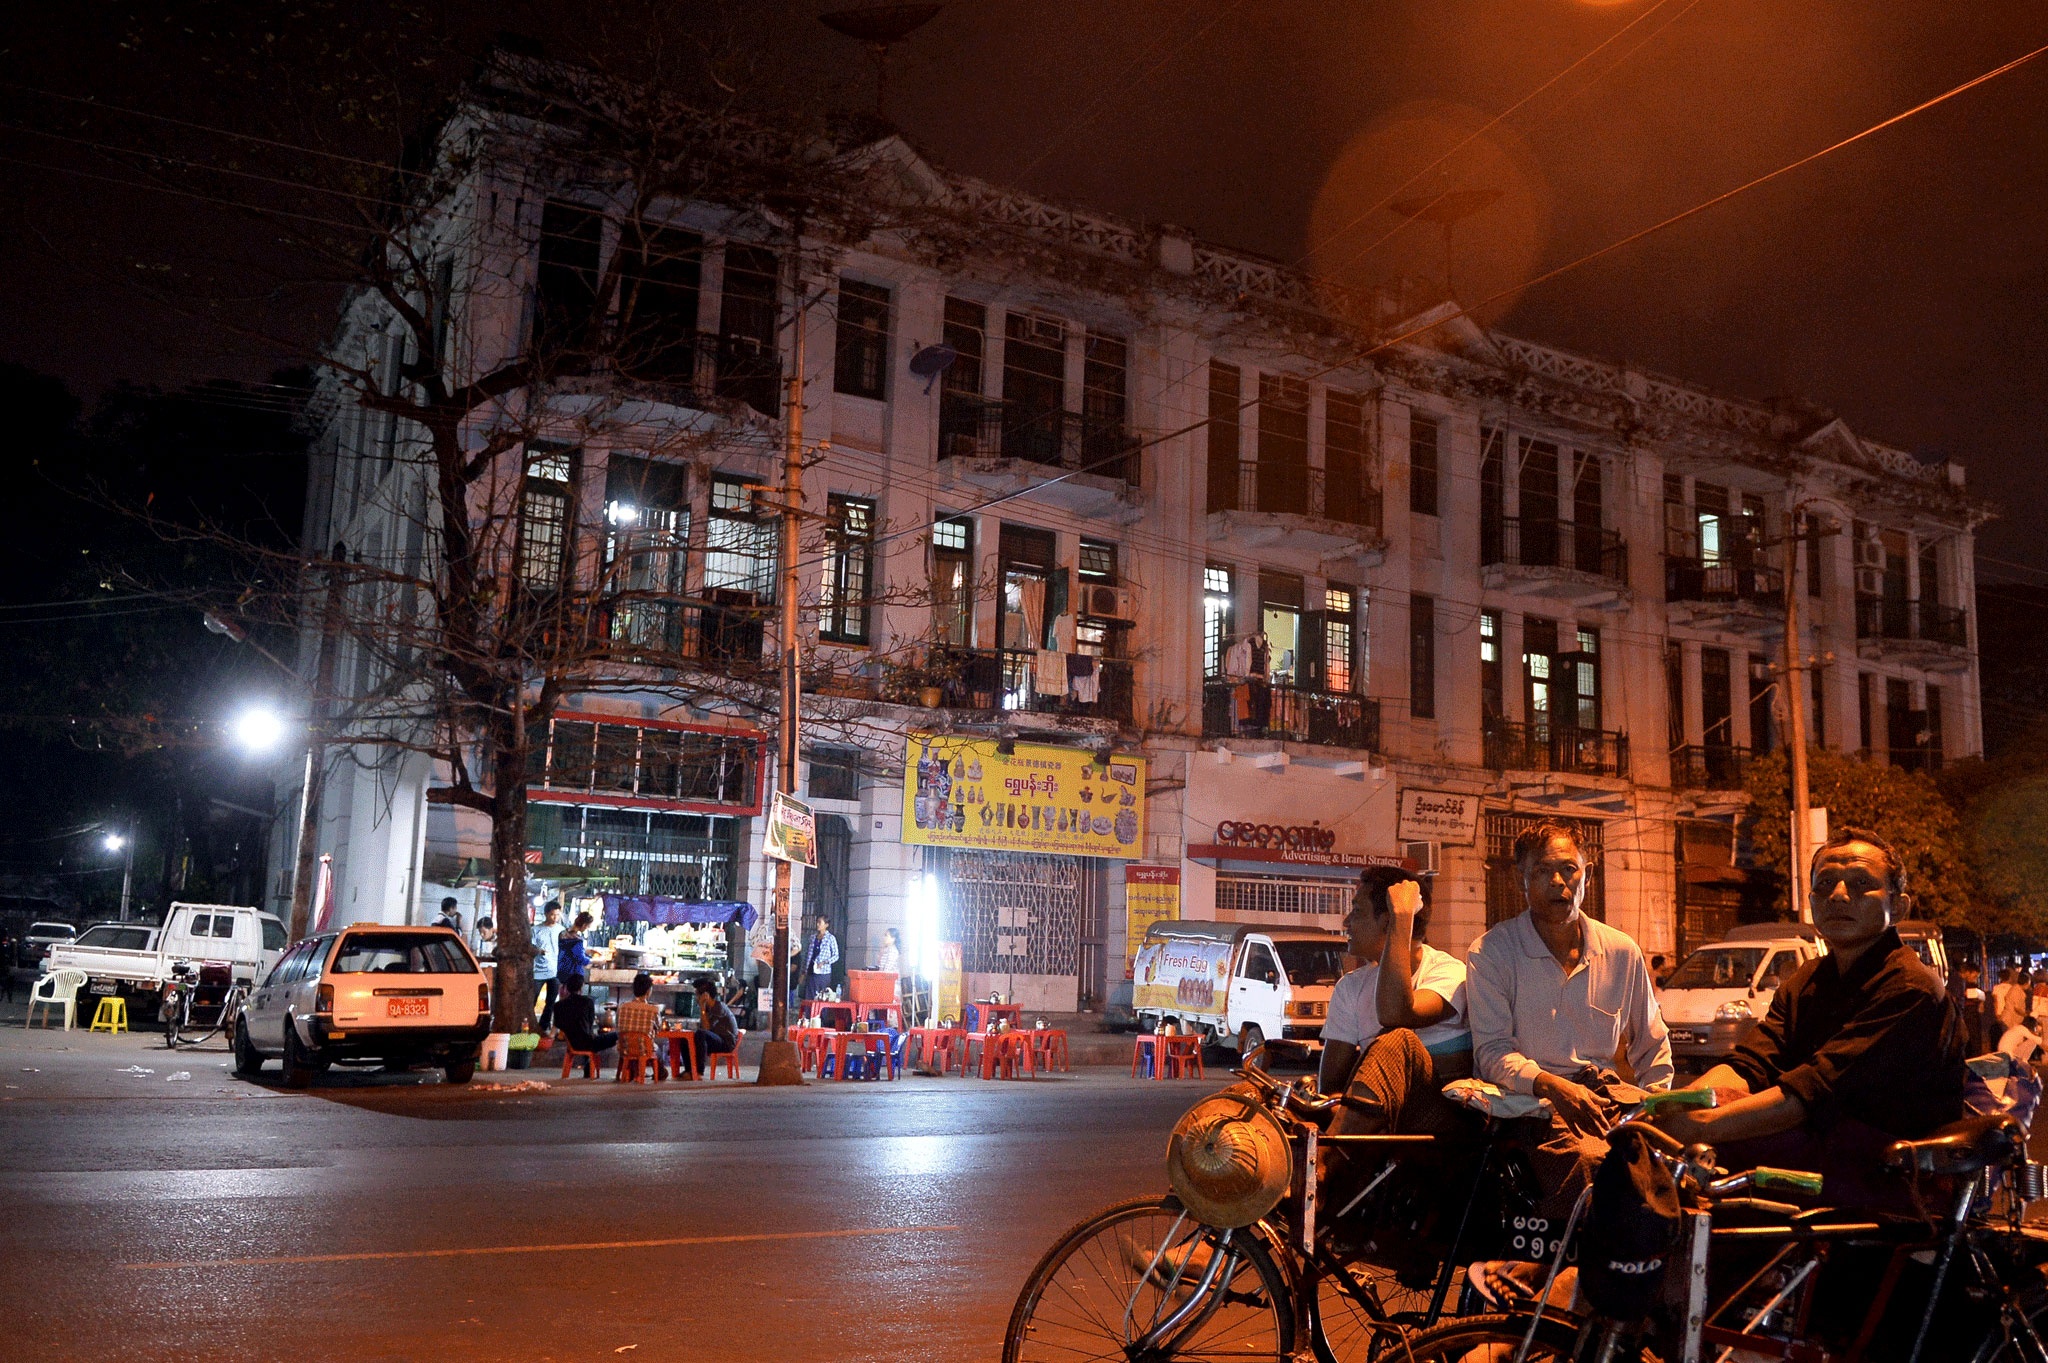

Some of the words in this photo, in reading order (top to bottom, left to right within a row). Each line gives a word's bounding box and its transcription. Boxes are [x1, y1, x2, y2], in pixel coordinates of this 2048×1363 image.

[1281, 850, 1331, 865] Advertising
[1332, 854, 1340, 863] &
[1341, 854, 1366, 864] Brand
[1368, 856, 1403, 867] Strategy
[1163, 954, 1188, 968] Fresh
[1189, 956, 1209, 973] Egg
[1608, 1258, 1663, 1275] POLO
